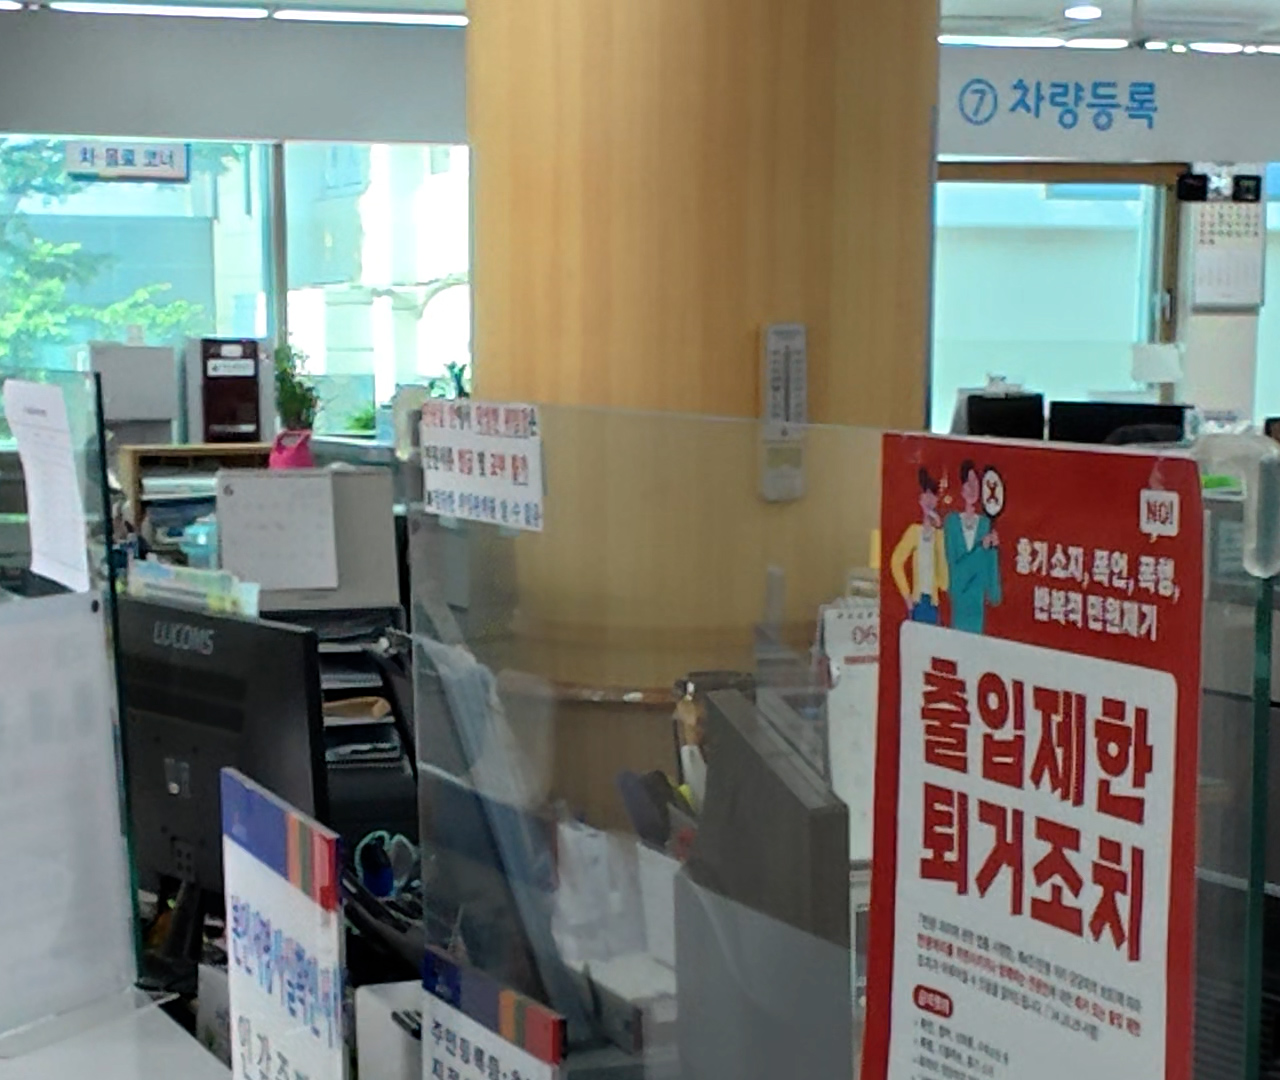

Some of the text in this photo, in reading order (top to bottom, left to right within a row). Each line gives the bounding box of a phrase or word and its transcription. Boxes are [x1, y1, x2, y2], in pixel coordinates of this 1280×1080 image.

[1009, 78, 1158, 132] 차량등록
[1147, 500, 1174, 526] NO!
[153, 621, 213, 655] LUCOMS
[921, 657, 1154, 825] 출입제한
[920, 781, 1144, 961] 퇴거조치
